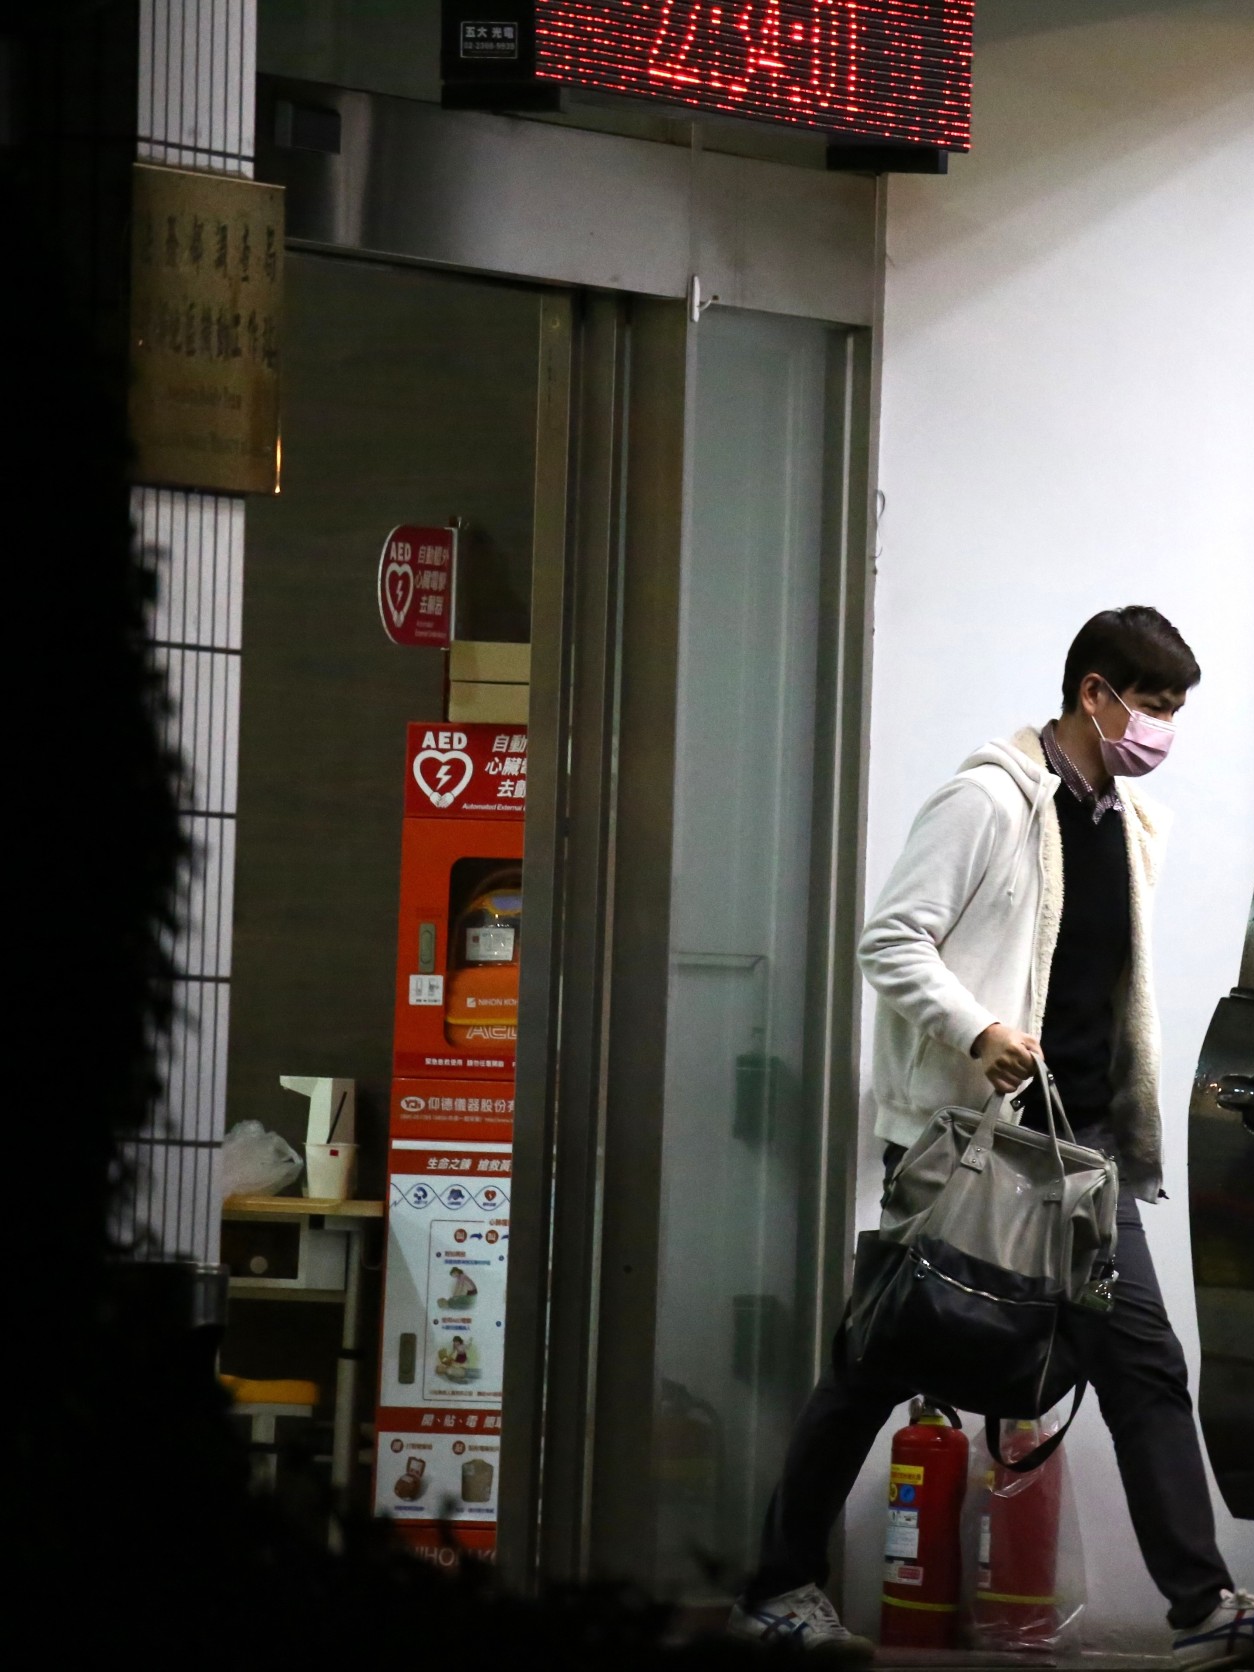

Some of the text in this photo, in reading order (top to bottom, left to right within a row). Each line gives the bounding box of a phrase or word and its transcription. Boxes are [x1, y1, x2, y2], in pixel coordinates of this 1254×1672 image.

[465, 26, 515, 39] 五大 光電
[390, 541, 412, 562] AED
[421, 731, 468, 750] AED
[462, 802, 522, 812] Automated External
